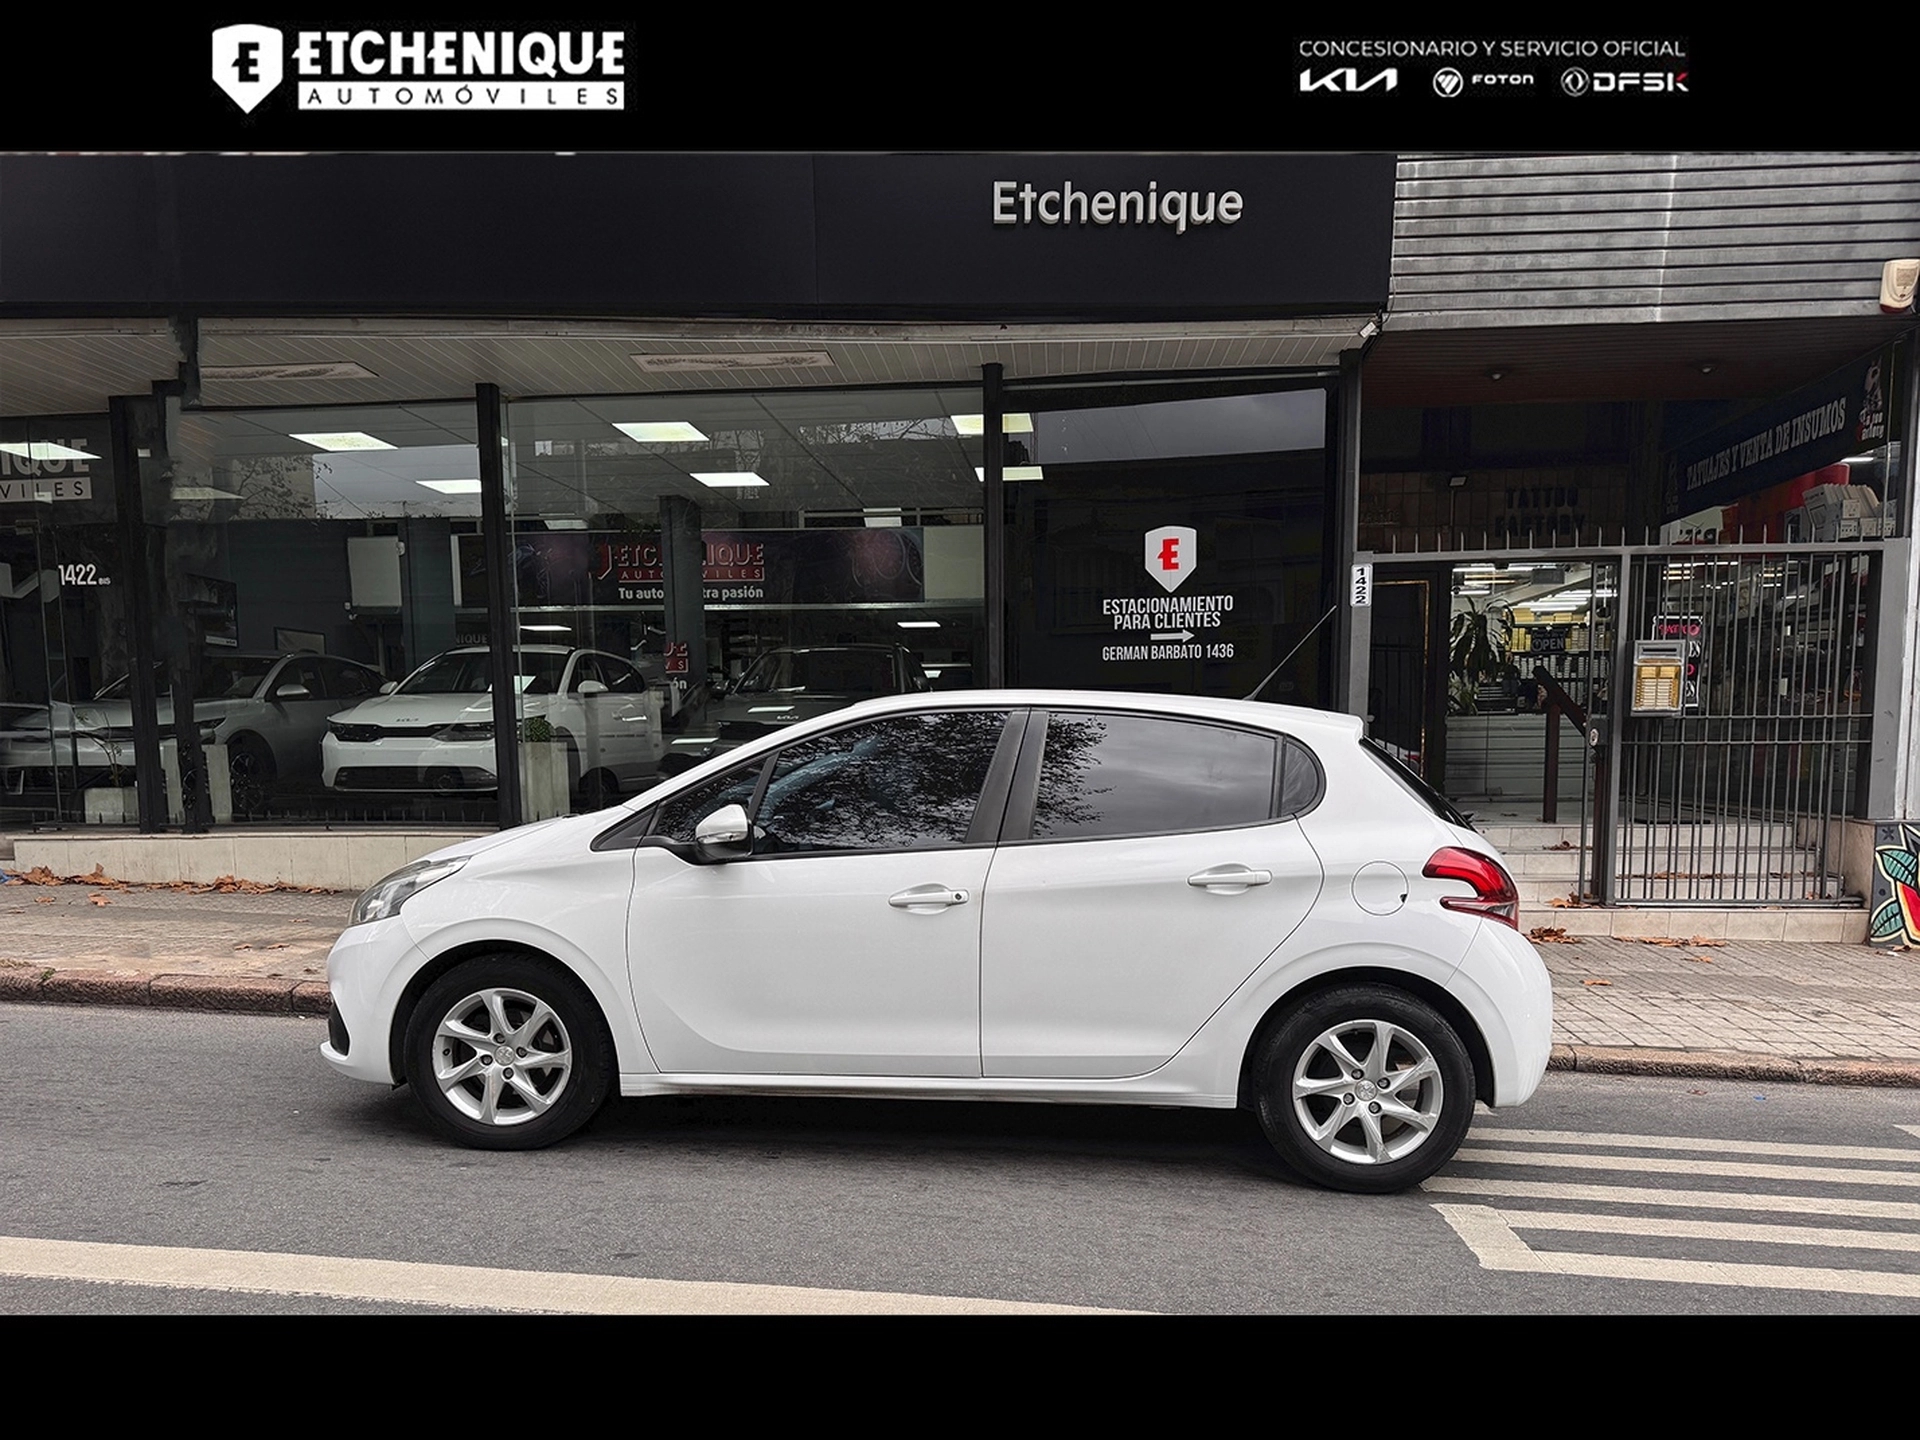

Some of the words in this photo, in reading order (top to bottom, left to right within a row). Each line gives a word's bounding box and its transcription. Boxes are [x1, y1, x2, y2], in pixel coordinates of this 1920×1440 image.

[993, 180, 1244, 235] Etchenique
[1686, 447, 1731, 491] TATUAJES
[1740, 429, 1774, 469] VENTA
[1774, 421, 1791, 455] DE
[1791, 396, 1847, 448] INSUMOS
[1505, 485, 1579, 508] TATTOO
[57, 564, 98, 586] 1422
[618, 587, 634, 600] Tu
[635, 587, 665, 600] auto
[721, 585, 764, 602] pasión
[1355, 567, 1367, 605] 1422
[1102, 595, 1234, 615] ESTACIONAMIENTO
[1113, 613, 1152, 630] PARA
[1154, 611, 1222, 629] CLIENTES
[1102, 645, 1149, 661] GERMAN
[1151, 644, 1202, 660] BARBATO
[1206, 643, 1235, 659] 1436
[1531, 637, 1565, 652] OPEN
